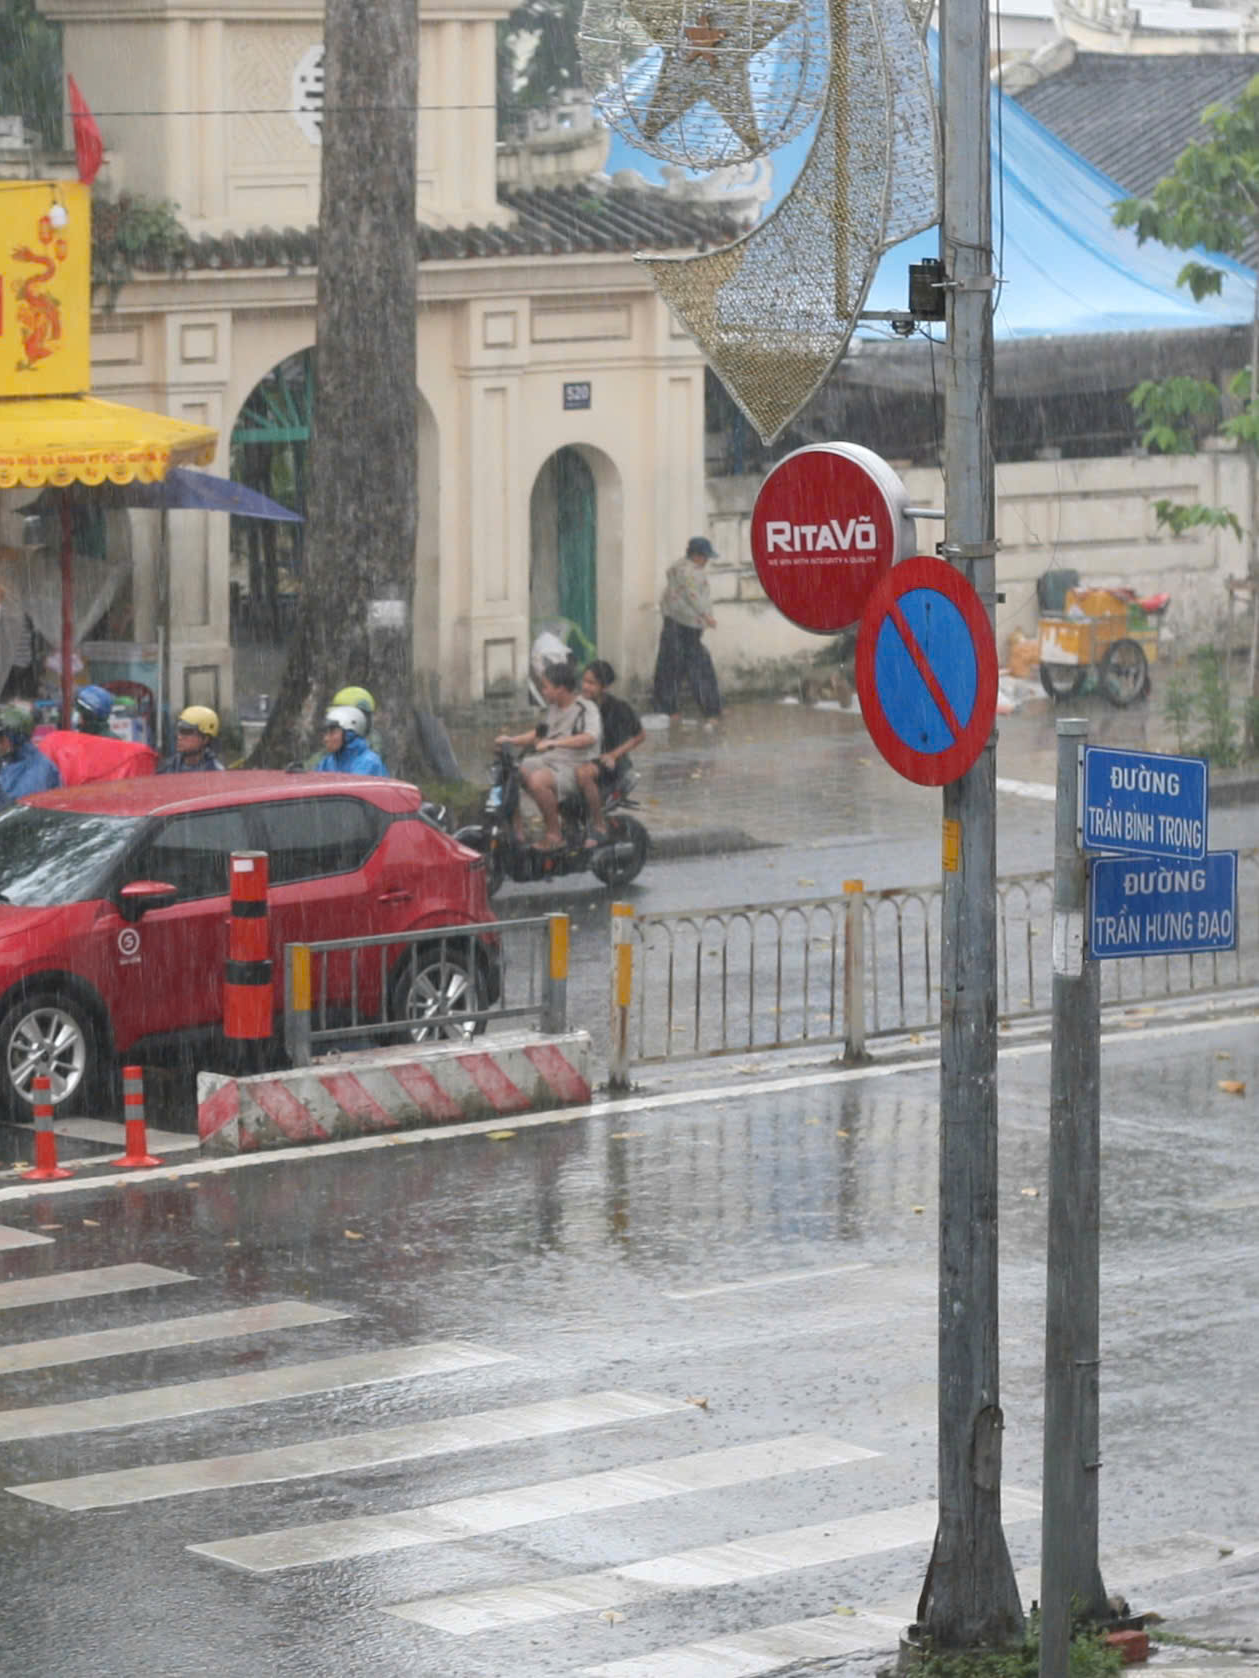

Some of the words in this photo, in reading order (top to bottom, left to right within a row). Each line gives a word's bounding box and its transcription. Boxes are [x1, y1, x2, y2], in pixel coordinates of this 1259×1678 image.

[1110, 763, 1181, 796] ĐƯỜNG
[1088, 796, 1122, 840] TRẦN
[1125, 804, 1155, 844] BÌNH
[1158, 815, 1202, 852] TRỌNG
[1123, 866, 1206, 896] ĐƯỜNG
[1096, 903, 1141, 945] TRẦN
[1146, 907, 1193, 943] HƯNG
[1198, 910, 1232, 945] ĐẠO
